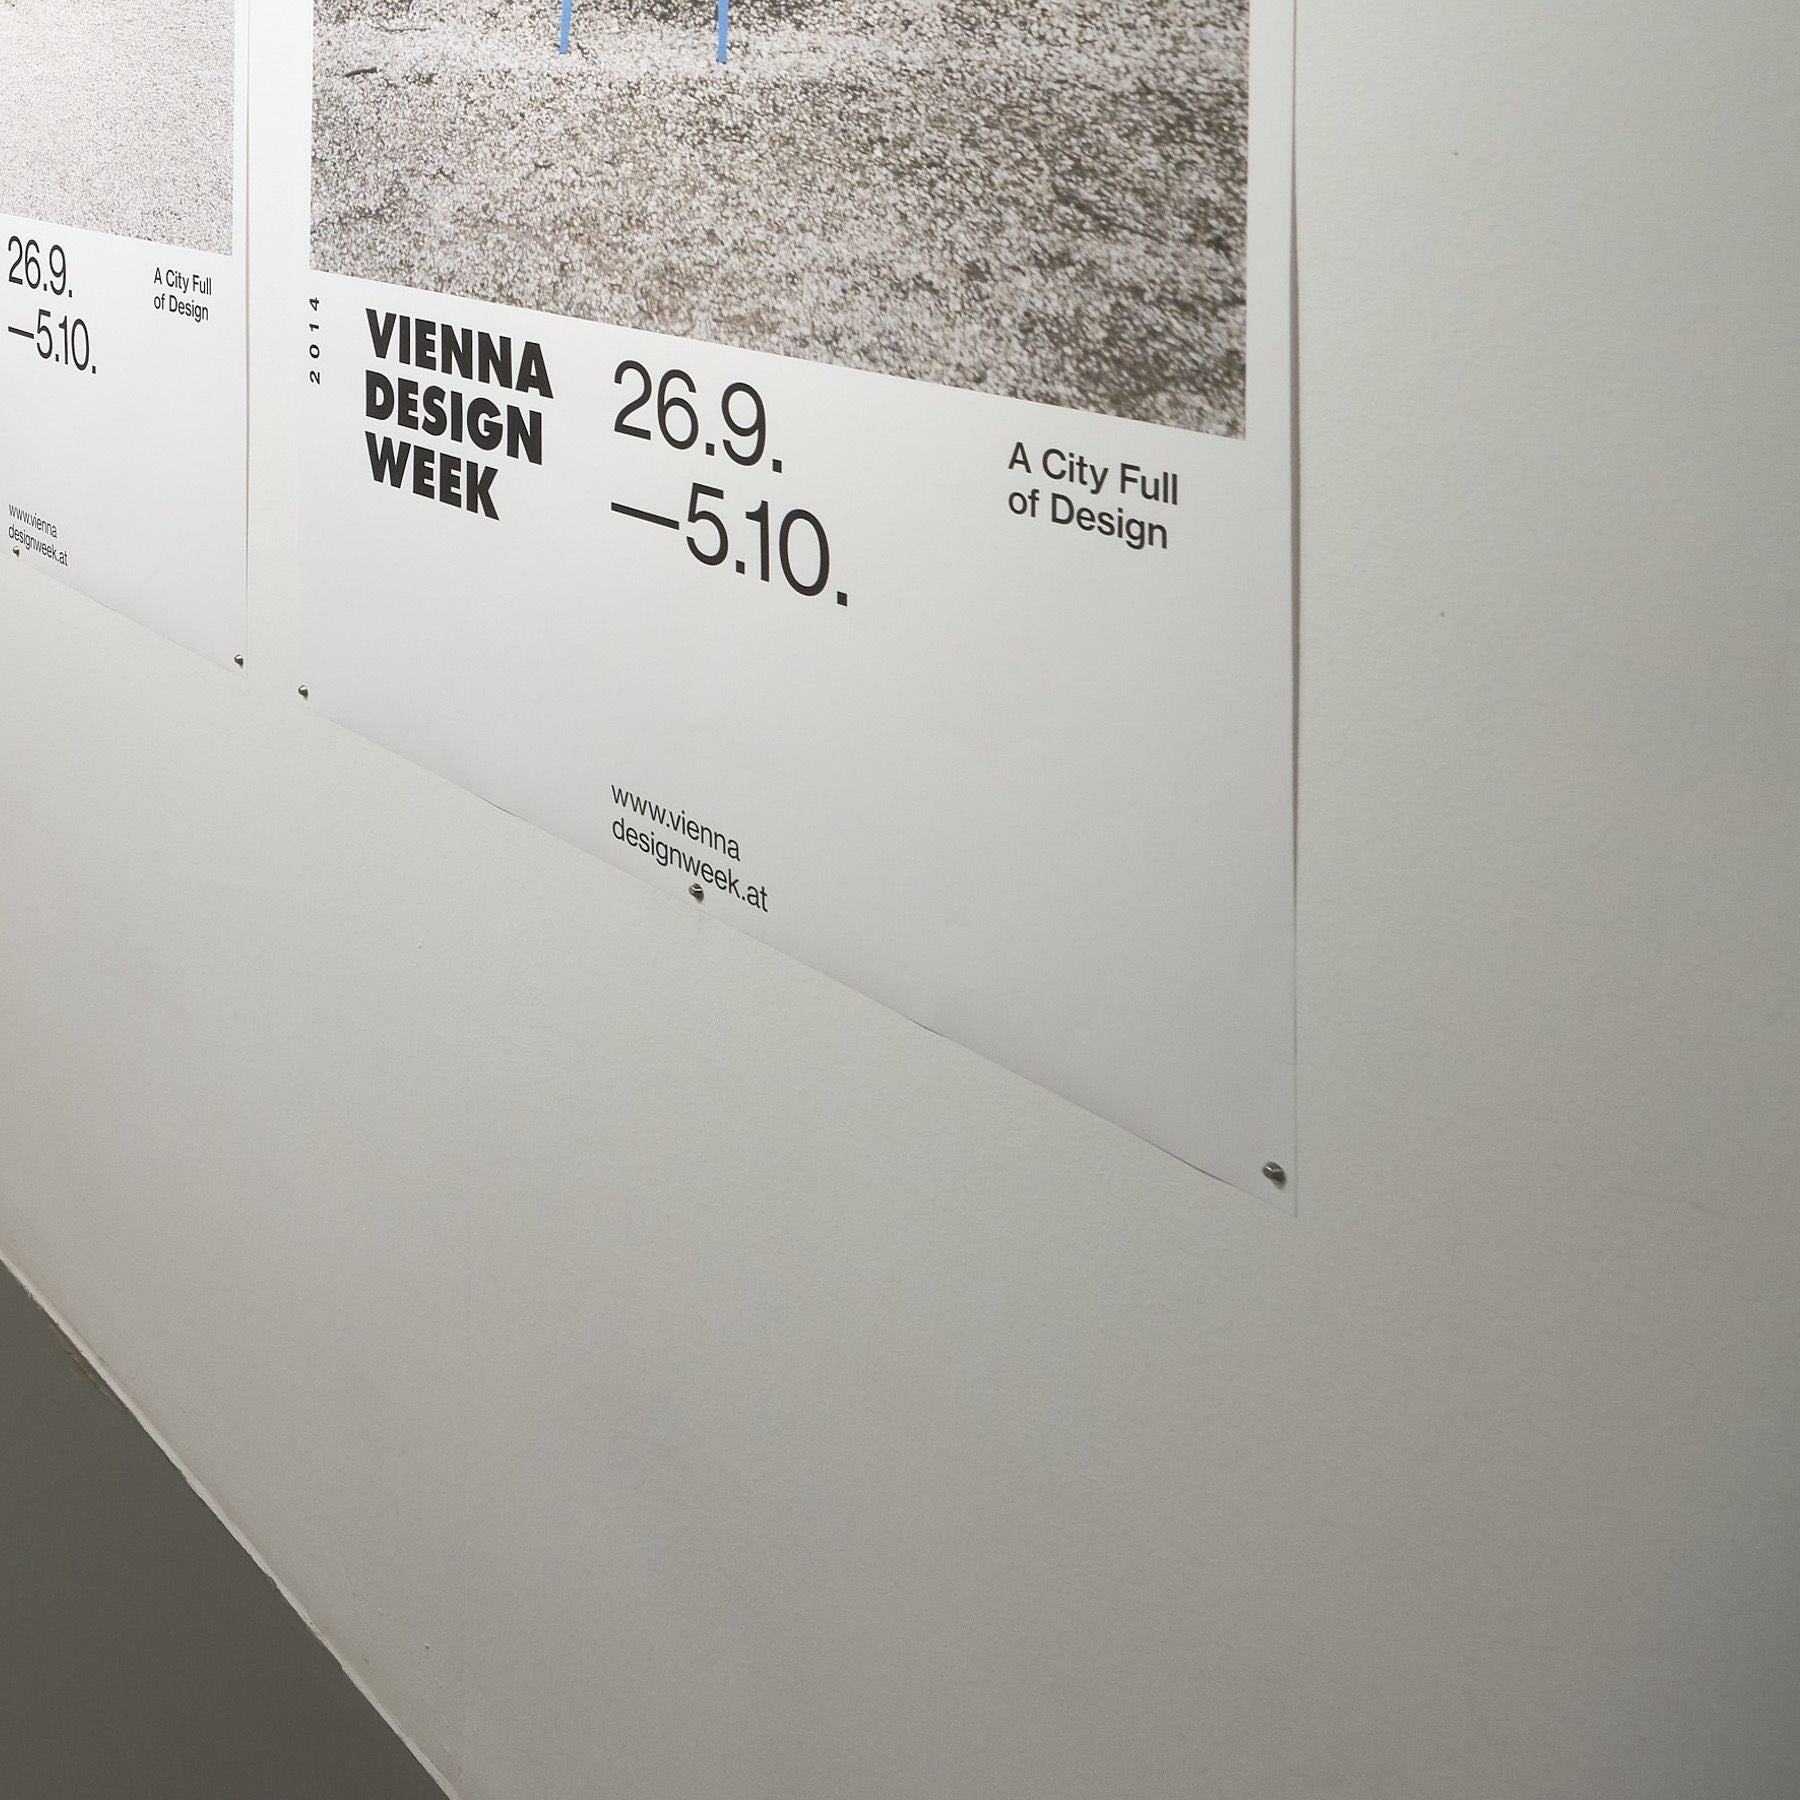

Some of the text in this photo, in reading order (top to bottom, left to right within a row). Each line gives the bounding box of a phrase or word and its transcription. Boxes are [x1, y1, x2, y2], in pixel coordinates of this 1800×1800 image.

[7, 235, 73, 298] 26.9.
[153, 267, 212, 296] A City Full
[153, 293, 209, 323] of Design
[308, 297, 320, 385] 2014
[365, 307, 783, 473] VIENNA 26.9.
[365, 369, 542, 466] DESIGN
[364, 430, 500, 521] WEEK
[1008, 442, 1179, 505] A City Full
[8, 503, 58, 539] www.vienna
[8, 523, 68, 567] designweek.at
[1008, 488, 1169, 550] of Design
[611, 783, 741, 863] www.vienna
[611, 816, 769, 913] designweek.at
